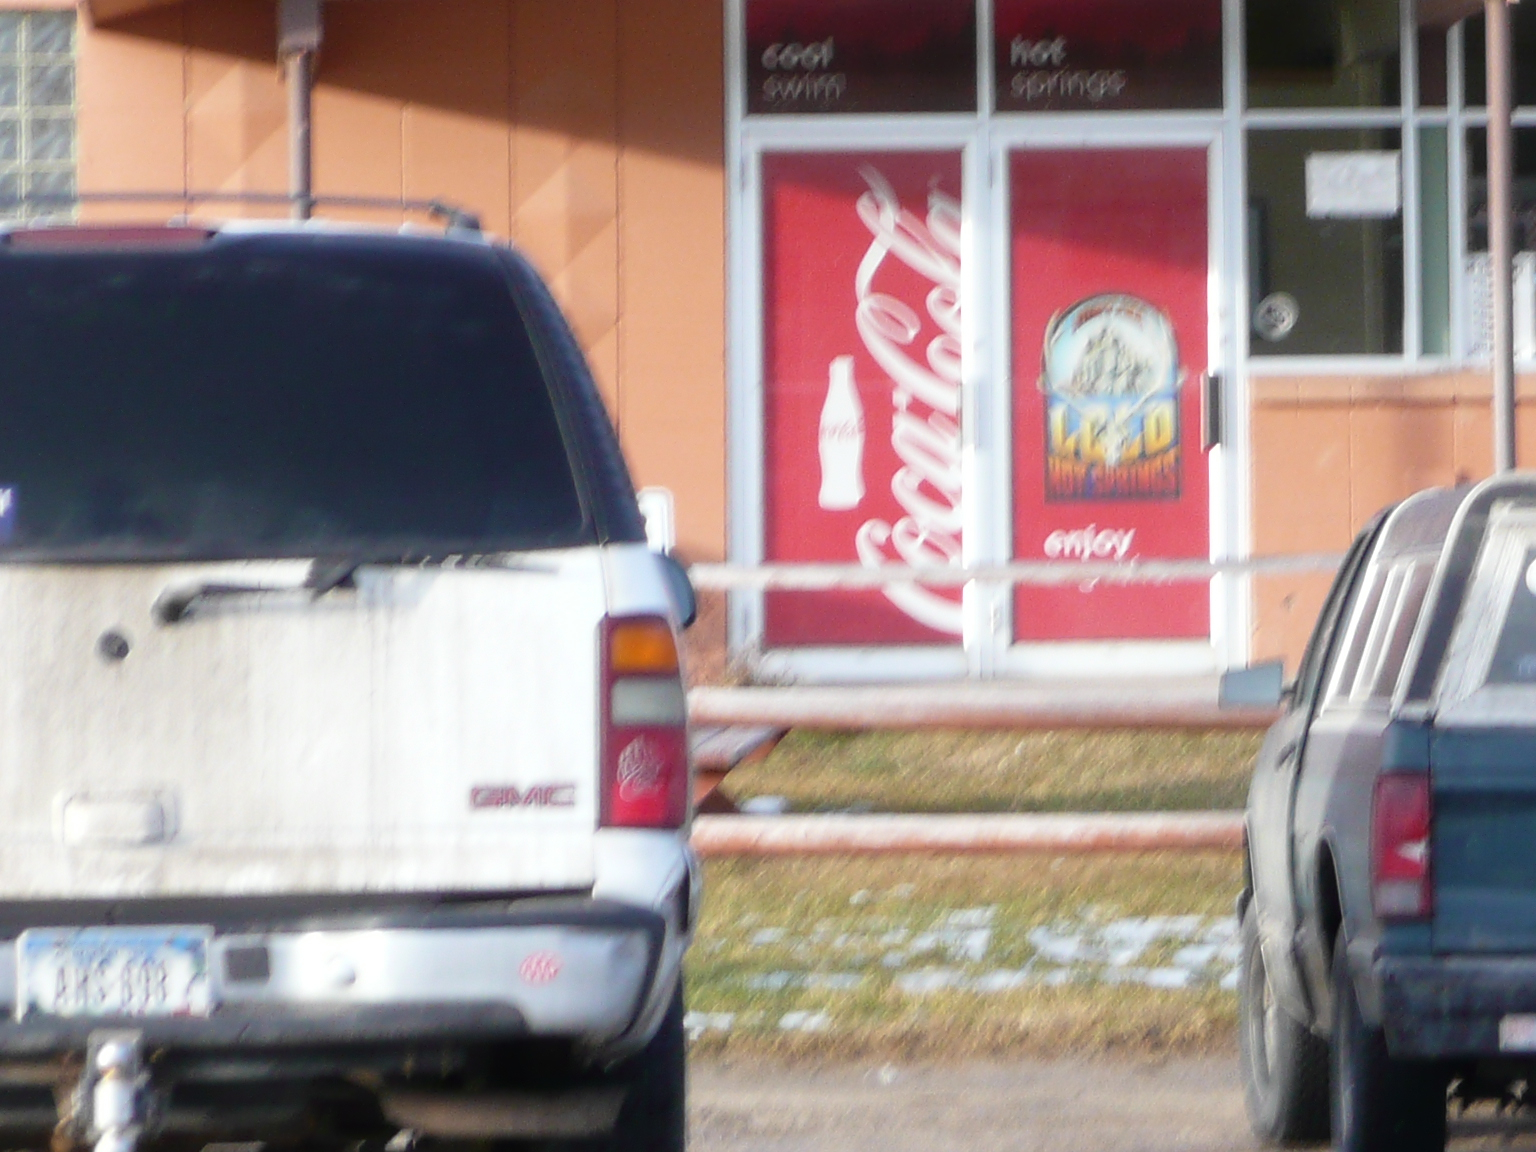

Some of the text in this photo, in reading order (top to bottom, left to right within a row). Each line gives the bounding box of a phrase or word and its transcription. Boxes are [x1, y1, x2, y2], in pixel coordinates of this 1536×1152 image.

[762, 36, 835, 69] cool
[1010, 33, 1067, 66] hot
[762, 71, 847, 101] swim
[1010, 68, 1126, 103] springs
[1043, 523, 1137, 563] enjoy
[470, 784, 576, 808] GMC
